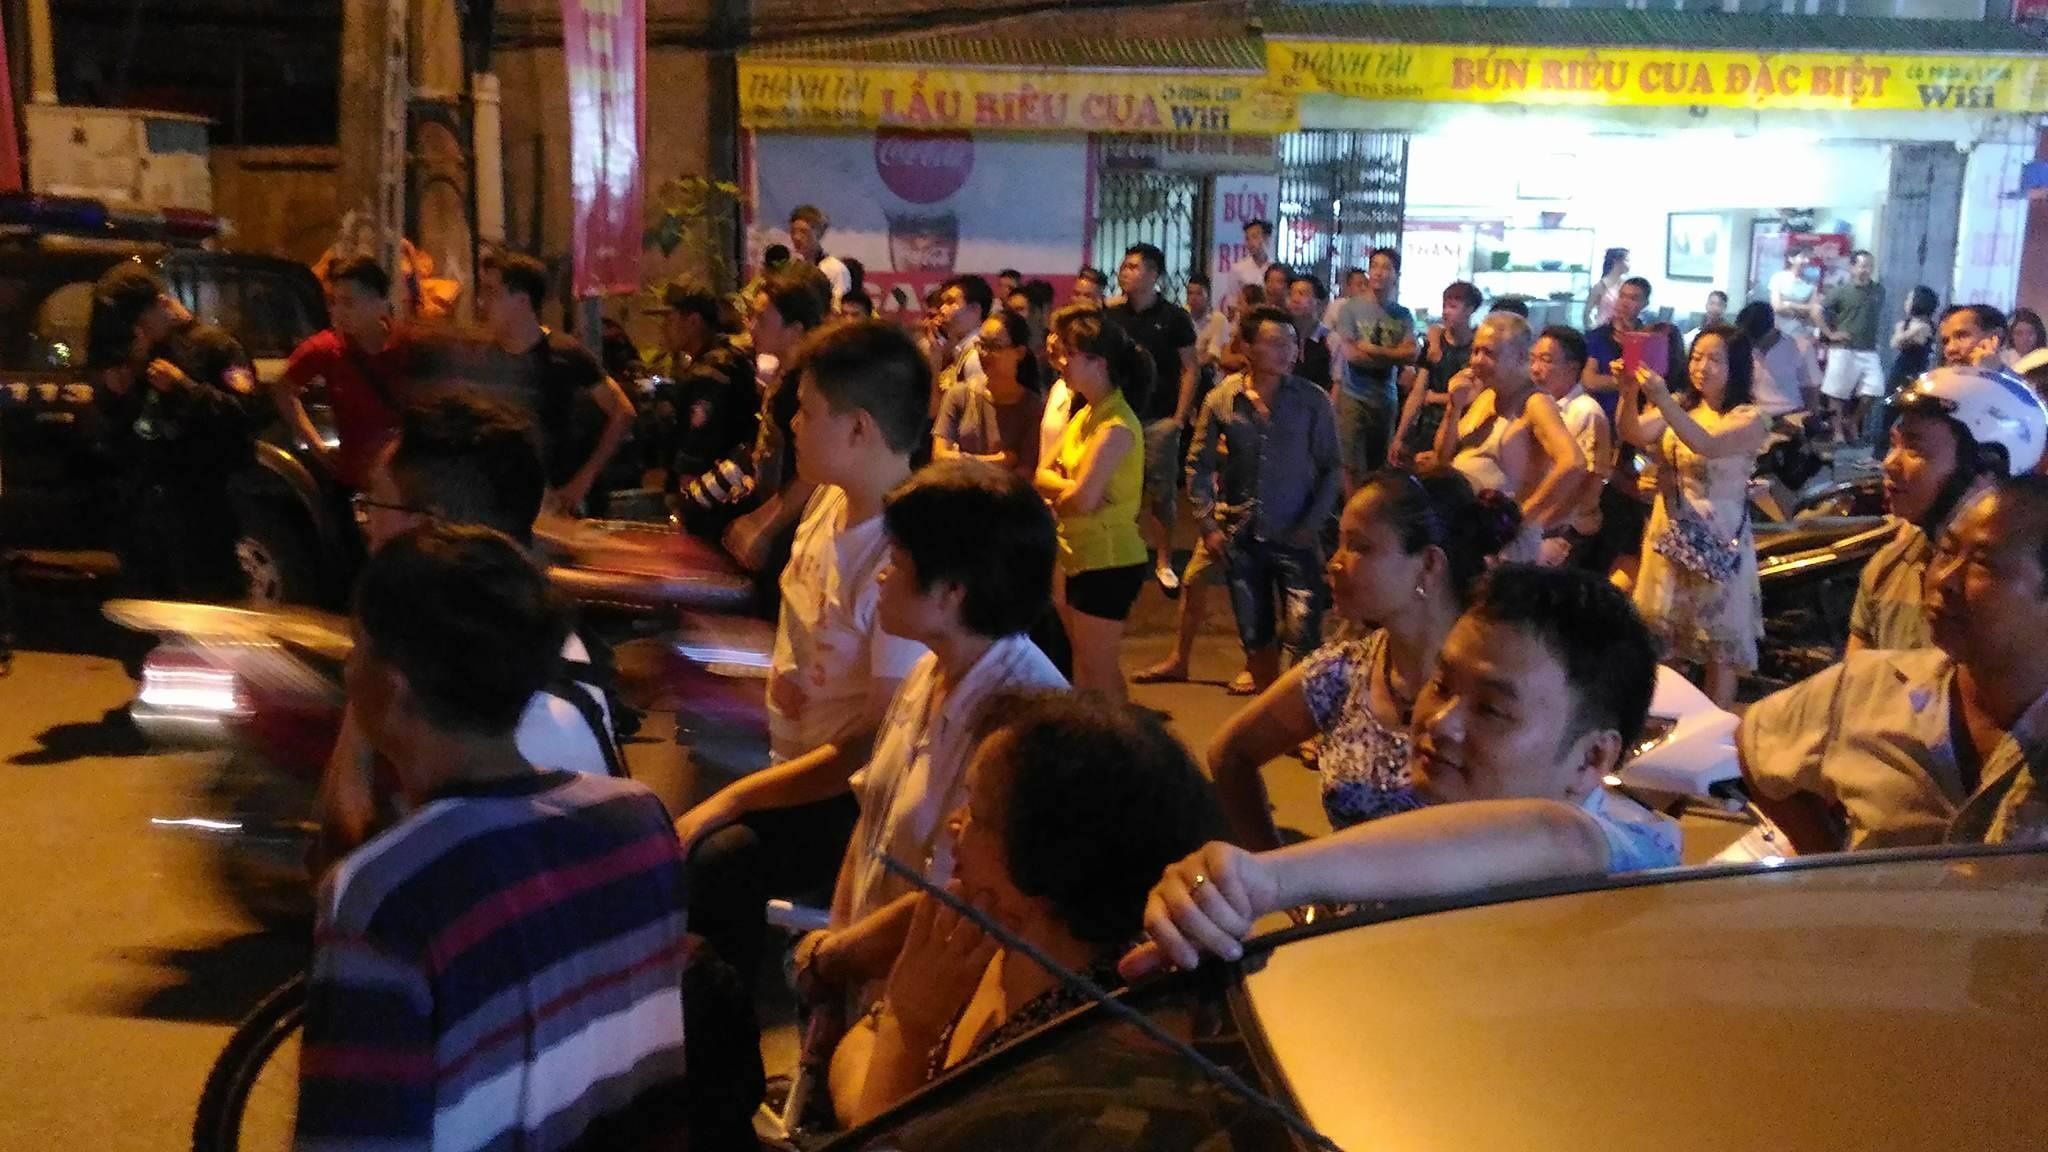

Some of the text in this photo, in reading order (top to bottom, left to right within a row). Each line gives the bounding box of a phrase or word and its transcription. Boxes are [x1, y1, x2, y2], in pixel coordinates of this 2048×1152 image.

[879, 69, 1162, 127] LẨU RIÊU CUA
[1451, 47, 1893, 107] BÚN RIÊU CUA ĐẶC BIỆT
[1223, 183, 1269, 222] BÚN
